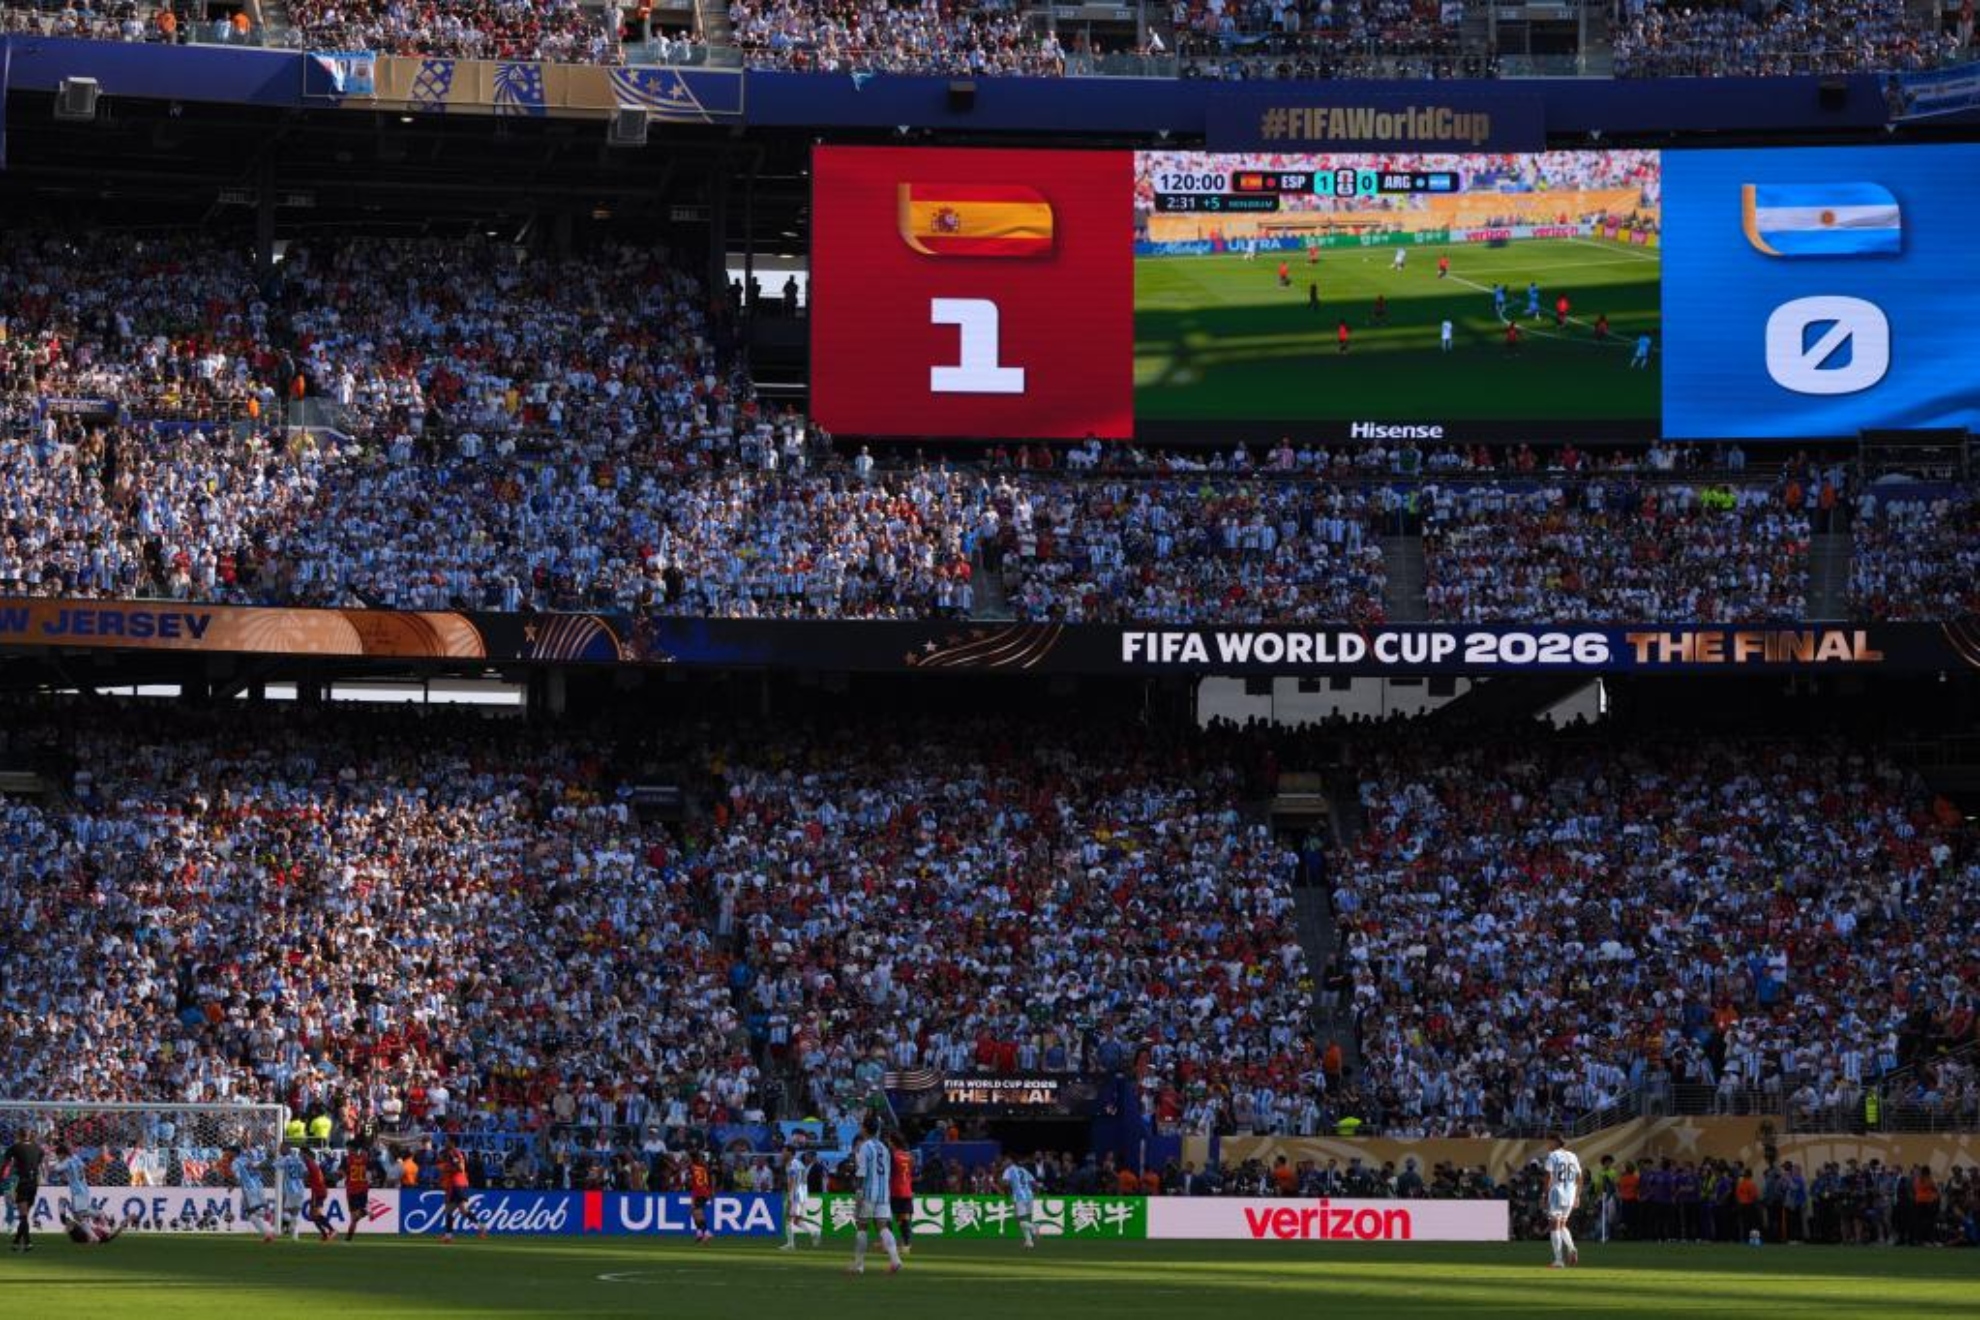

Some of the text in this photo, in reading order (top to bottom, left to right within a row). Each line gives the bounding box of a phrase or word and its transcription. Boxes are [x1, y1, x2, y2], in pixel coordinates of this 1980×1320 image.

[1262, 106, 1490, 145] #FIFAWorldCup
[1160, 173, 1226, 190] 120:00
[1281, 175, 1411, 190] ESP 1 0 ARG
[1166, 197, 1196, 210] 2:31
[930, 298, 1025, 393] 1
[1765, 296, 1890, 395] 0
[1351, 421, 1443, 438] Hisense
[1122, 631, 1884, 663] FIFA WORLD CUP 2026 THE FINAL
[944, 1079, 965, 1089] FIFA
[967, 1079, 1001, 1089] WORLD
[1002, 1079, 1022, 1089] CUP
[945, 1089, 1058, 1103] THE FINAL
[122, 1197, 168, 1222] OF
[1071, 1199, 1134, 1236] 蒙牛
[1244, 1197, 1412, 1240] verizon
